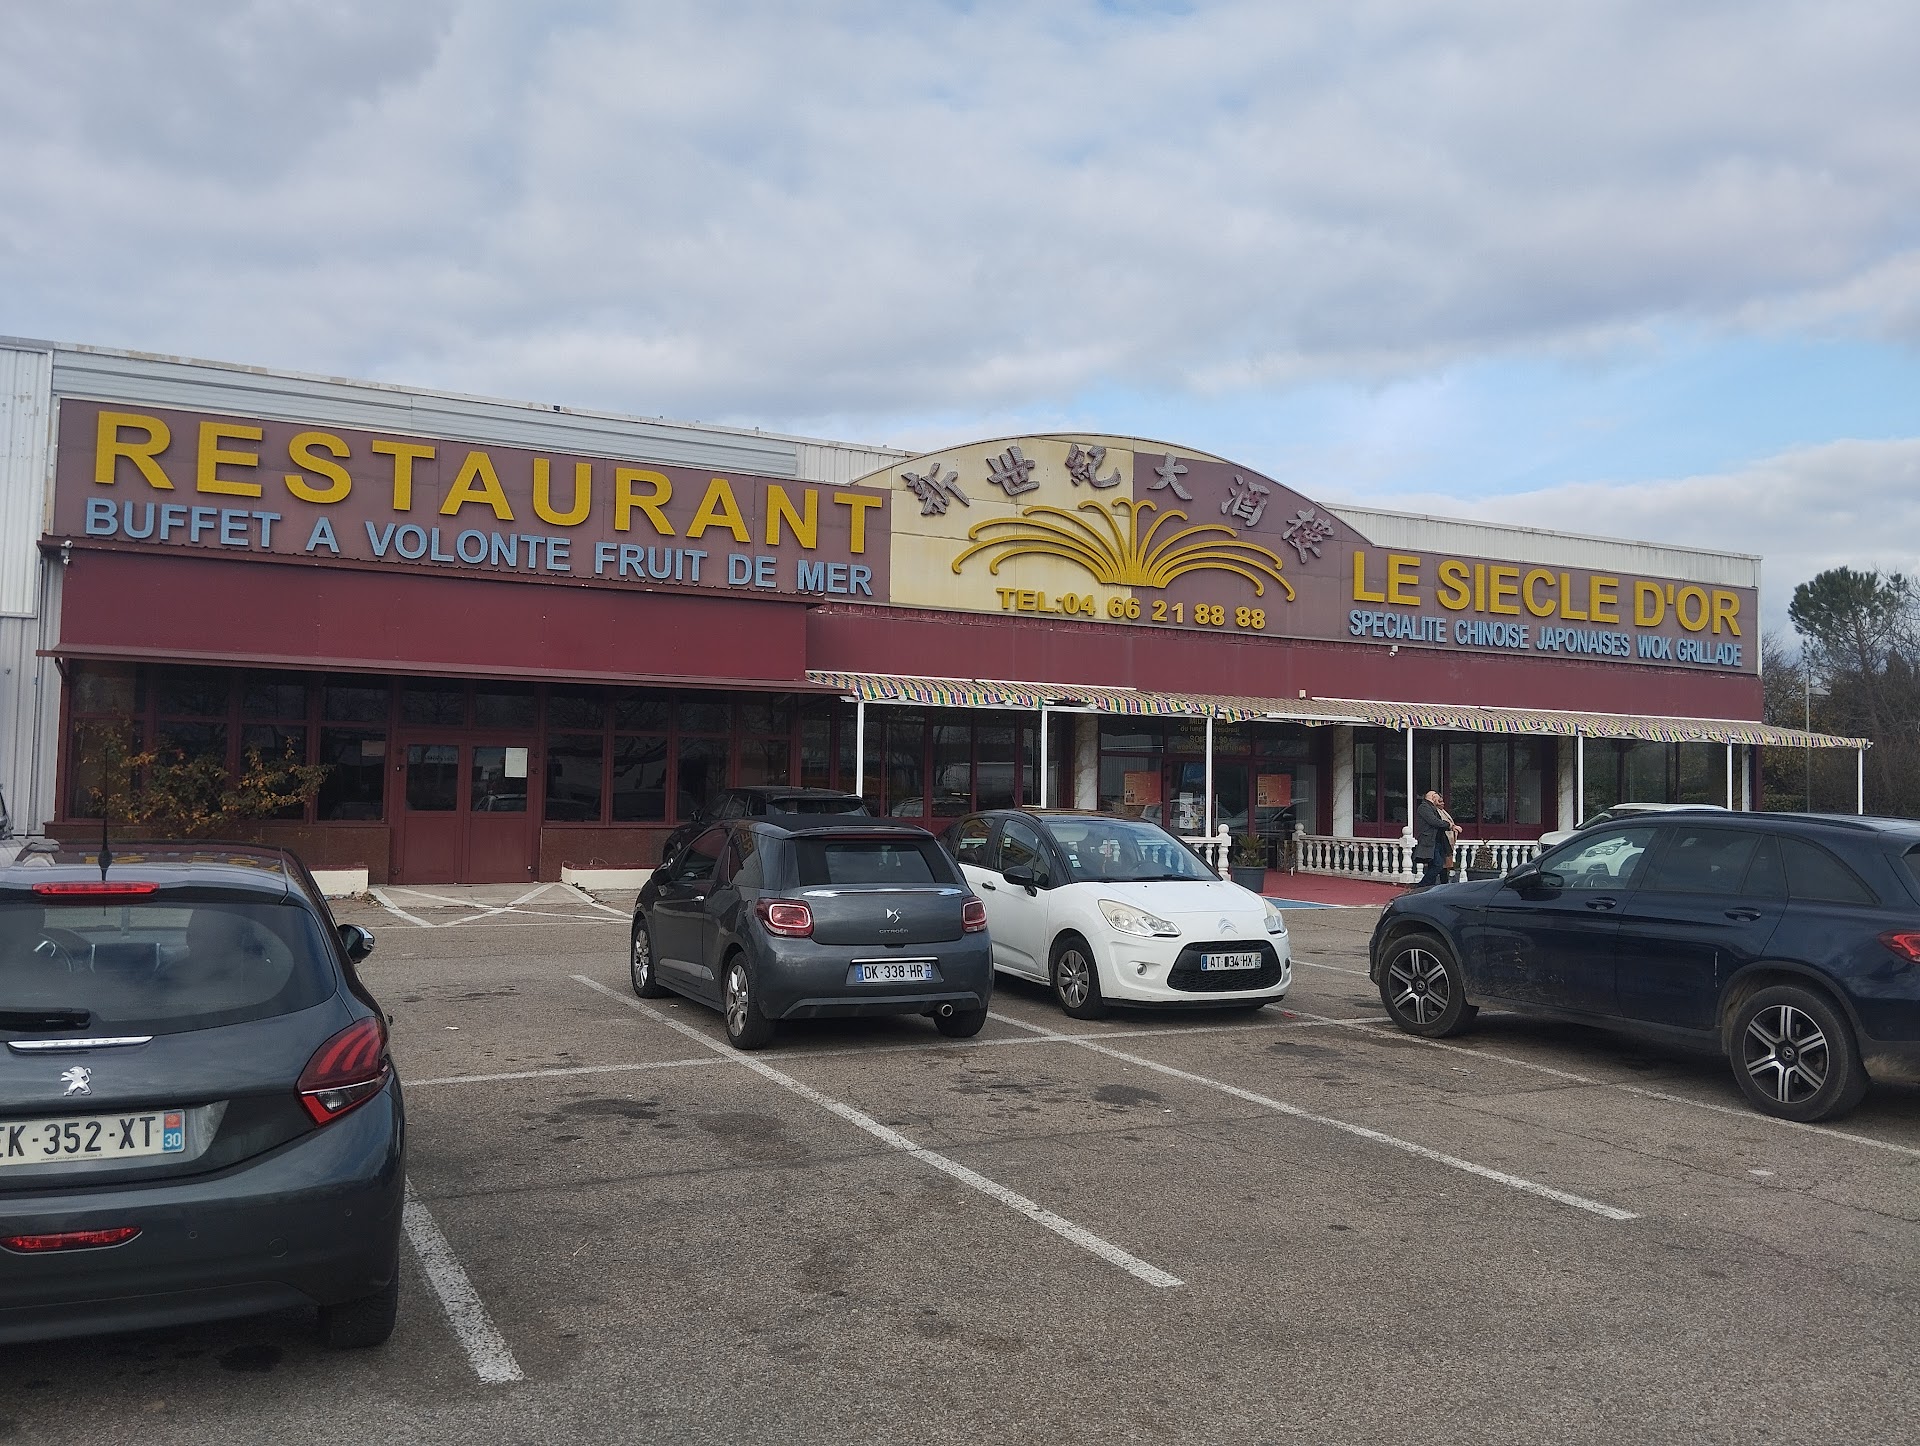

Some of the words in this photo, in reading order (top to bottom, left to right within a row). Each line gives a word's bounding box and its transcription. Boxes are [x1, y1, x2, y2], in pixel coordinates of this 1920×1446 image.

[95, 410, 882, 554] RESTAURANT
[85, 497, 281, 548] BUFFET
[305, 516, 340, 554] A
[365, 520, 571, 572] VOLONTE
[594, 541, 708, 582] FRUIT
[728, 553, 777, 588] DE
[797, 559, 873, 596] MER
[1107, 595, 1141, 619] 66
[1150, 599, 1184, 624] 21
[1194, 603, 1226, 627] 88
[1235, 606, 1266, 630] 88
[1353, 550, 1421, 607] LE
[1436, 559, 1620, 624] SIECLE
[1634, 580, 1742, 636] D'OR
[1349, 609, 1447, 644] SPECIALITE
[1455, 619, 1530, 650] CHINOISE
[1536, 626, 1631, 658] JAPONAISES
[1637, 634, 1673, 660] WOK
[1676, 638, 1743, 667] GRILLADE
[864, 964, 924, 979] DK-338-HR
[164, 1132, 182, 1147] 30
